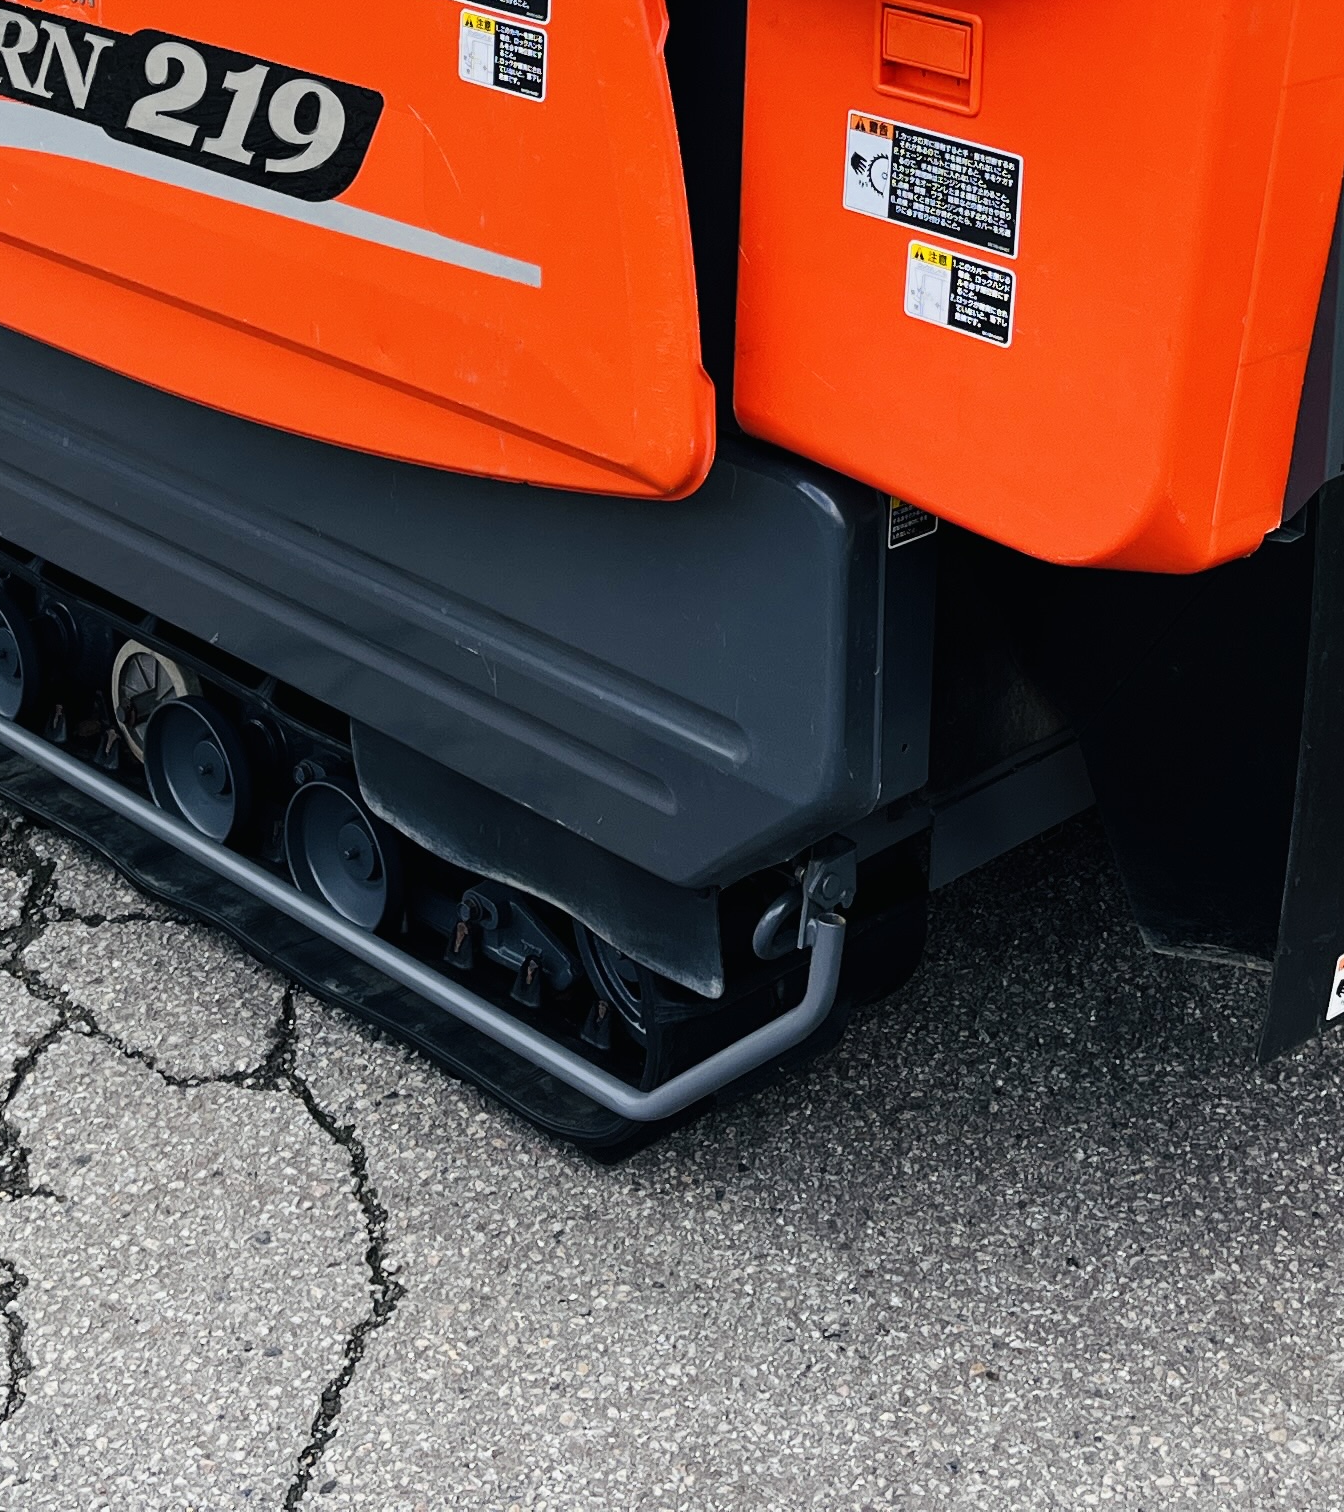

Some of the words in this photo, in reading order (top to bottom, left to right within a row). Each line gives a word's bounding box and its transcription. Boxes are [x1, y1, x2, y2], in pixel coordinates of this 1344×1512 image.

[124, 40, 346, 174] 219
[869, 121, 889, 136] 警告
[928, 250, 946, 266] 注意
